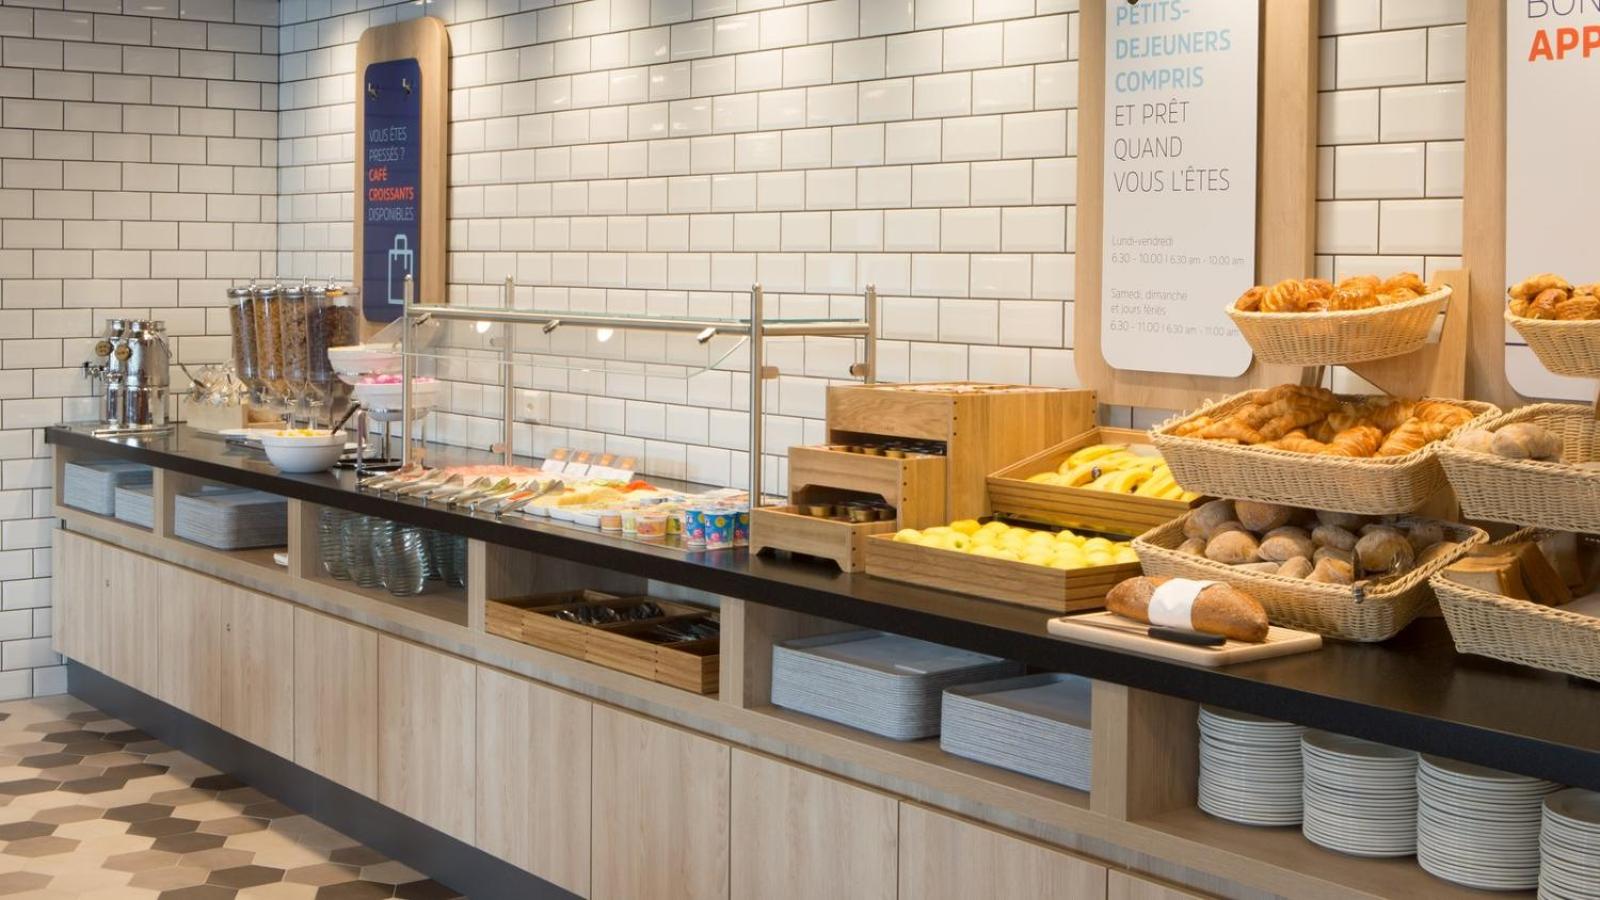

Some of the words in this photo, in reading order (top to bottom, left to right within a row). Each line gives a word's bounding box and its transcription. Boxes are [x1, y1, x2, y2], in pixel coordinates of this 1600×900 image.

[1116, 0, 1190, 26] PETITS-
[1116, 29, 1231, 60] DEJEUNERS
[1528, 25, 1600, 62] APP
[1115, 66, 1204, 93] COMPRIS
[1115, 104, 1135, 126] ET
[1142, 98, 1190, 125] PRÊT
[368, 128, 388, 142] VOUS
[390, 125, 407, 141] ÊTES
[368, 146, 398, 162] PRESSÉS
[1113, 136, 1183, 162] QUAND
[368, 165, 388, 182] CAFÉ
[1113, 170, 1164, 193] VOUS
[1171, 166, 1230, 192] L'ÊTES
[368, 187, 414, 202] CROISSANTS
[368, 207, 414, 222] DISPONIBLES
[1111, 235, 1174, 247] Lundi-vendredi
[1145, 289, 1188, 301] dimanche
